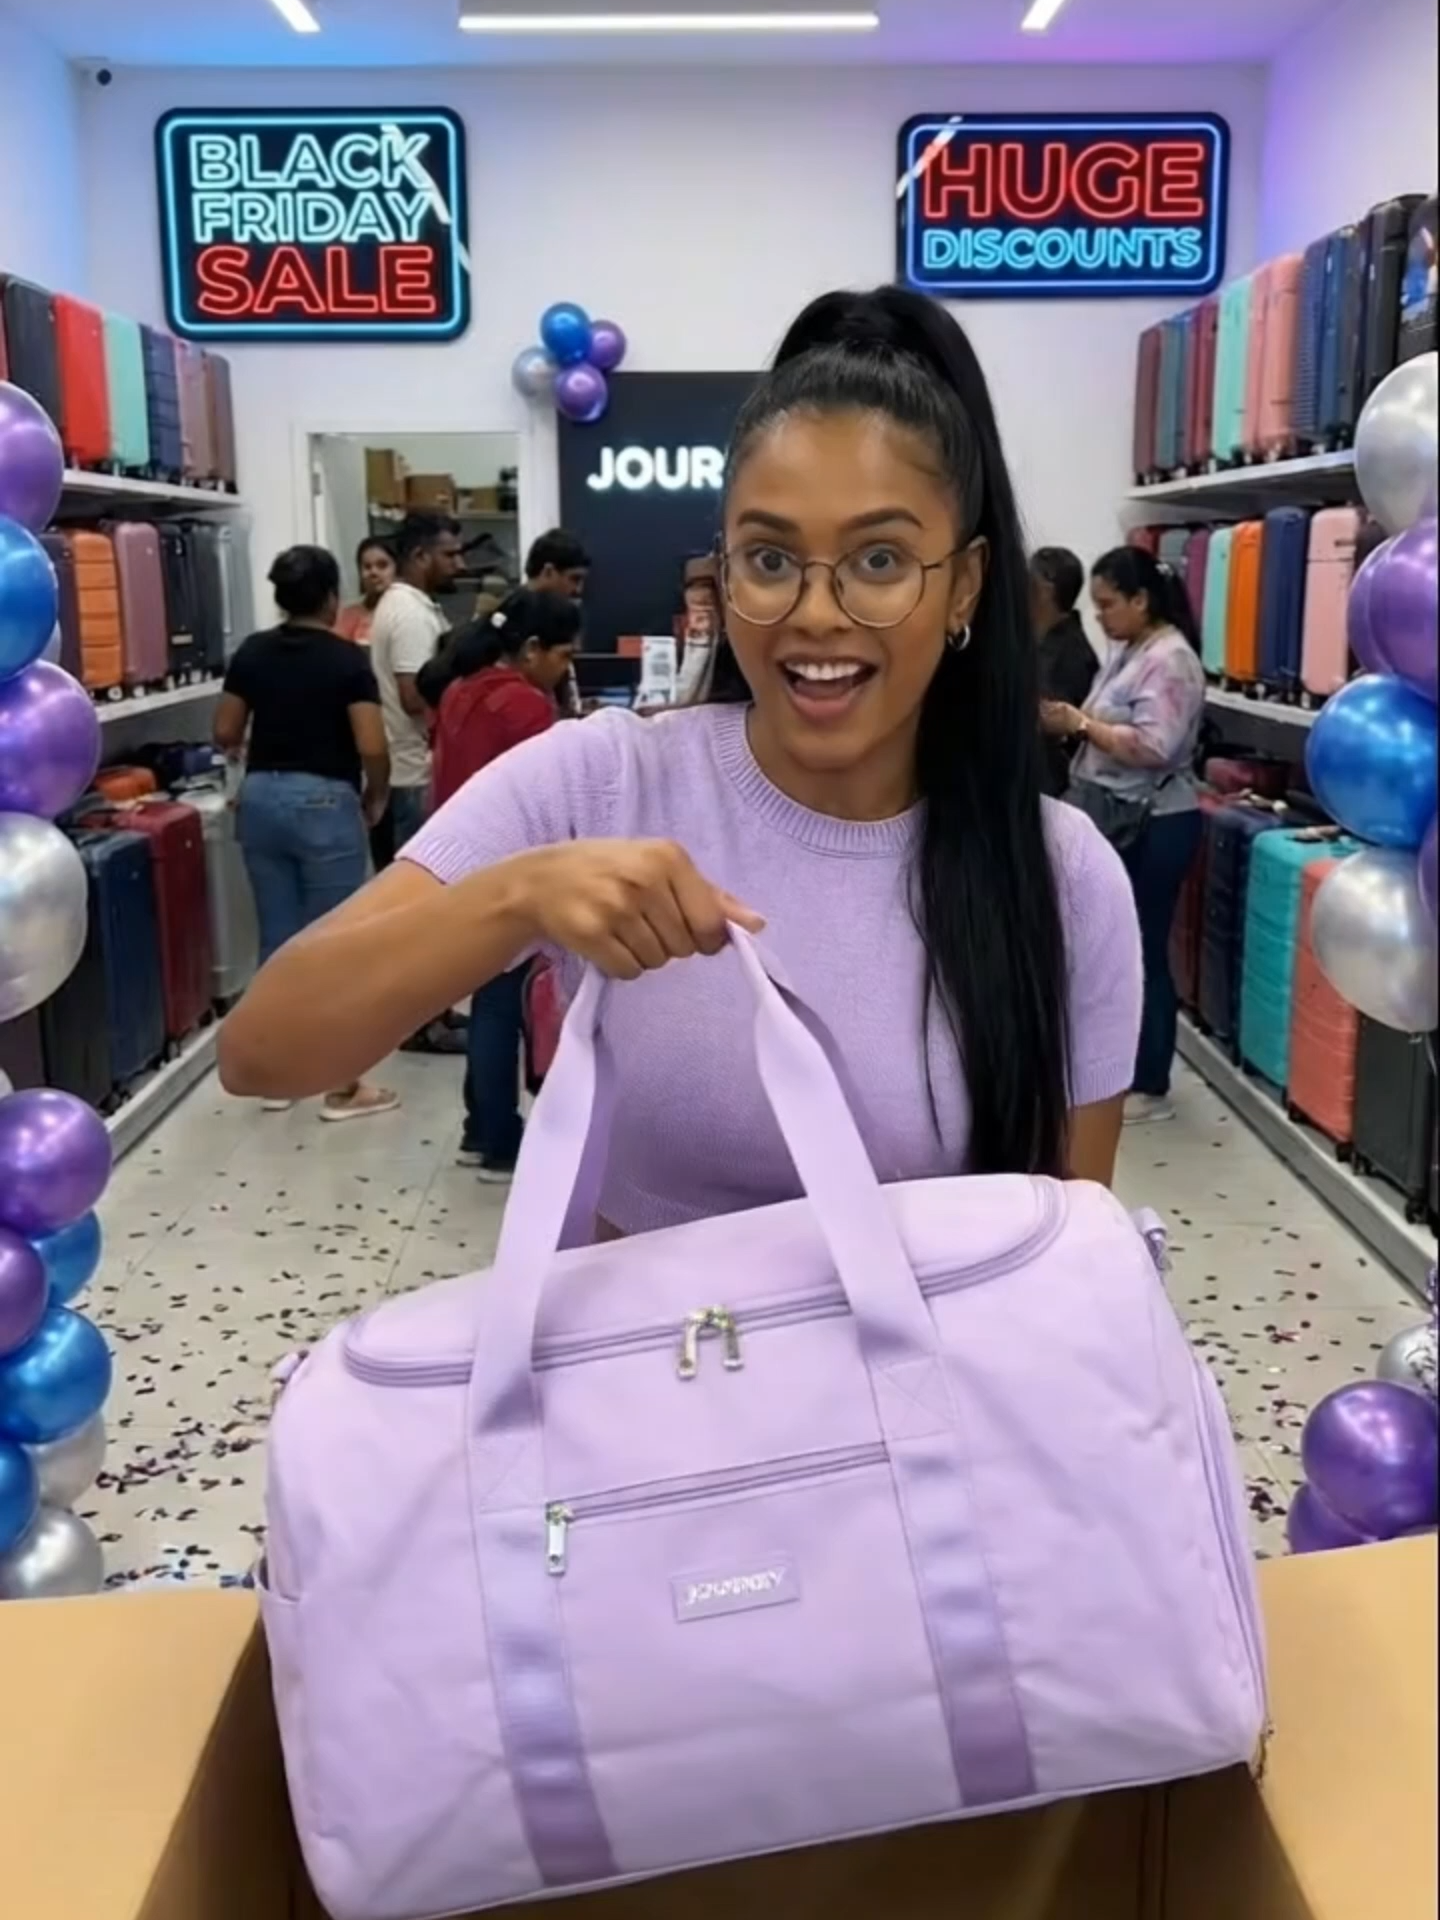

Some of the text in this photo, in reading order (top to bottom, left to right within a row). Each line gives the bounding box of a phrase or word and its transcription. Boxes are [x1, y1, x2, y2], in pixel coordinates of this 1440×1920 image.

[189, 133, 434, 189] BLACK
[922, 142, 1204, 219] HUGE
[192, 191, 432, 243] FRIDAY
[922, 226, 1202, 269] DISCOUNTS
[197, 245, 437, 315] SALE
[586, 446, 726, 490] JOUR
